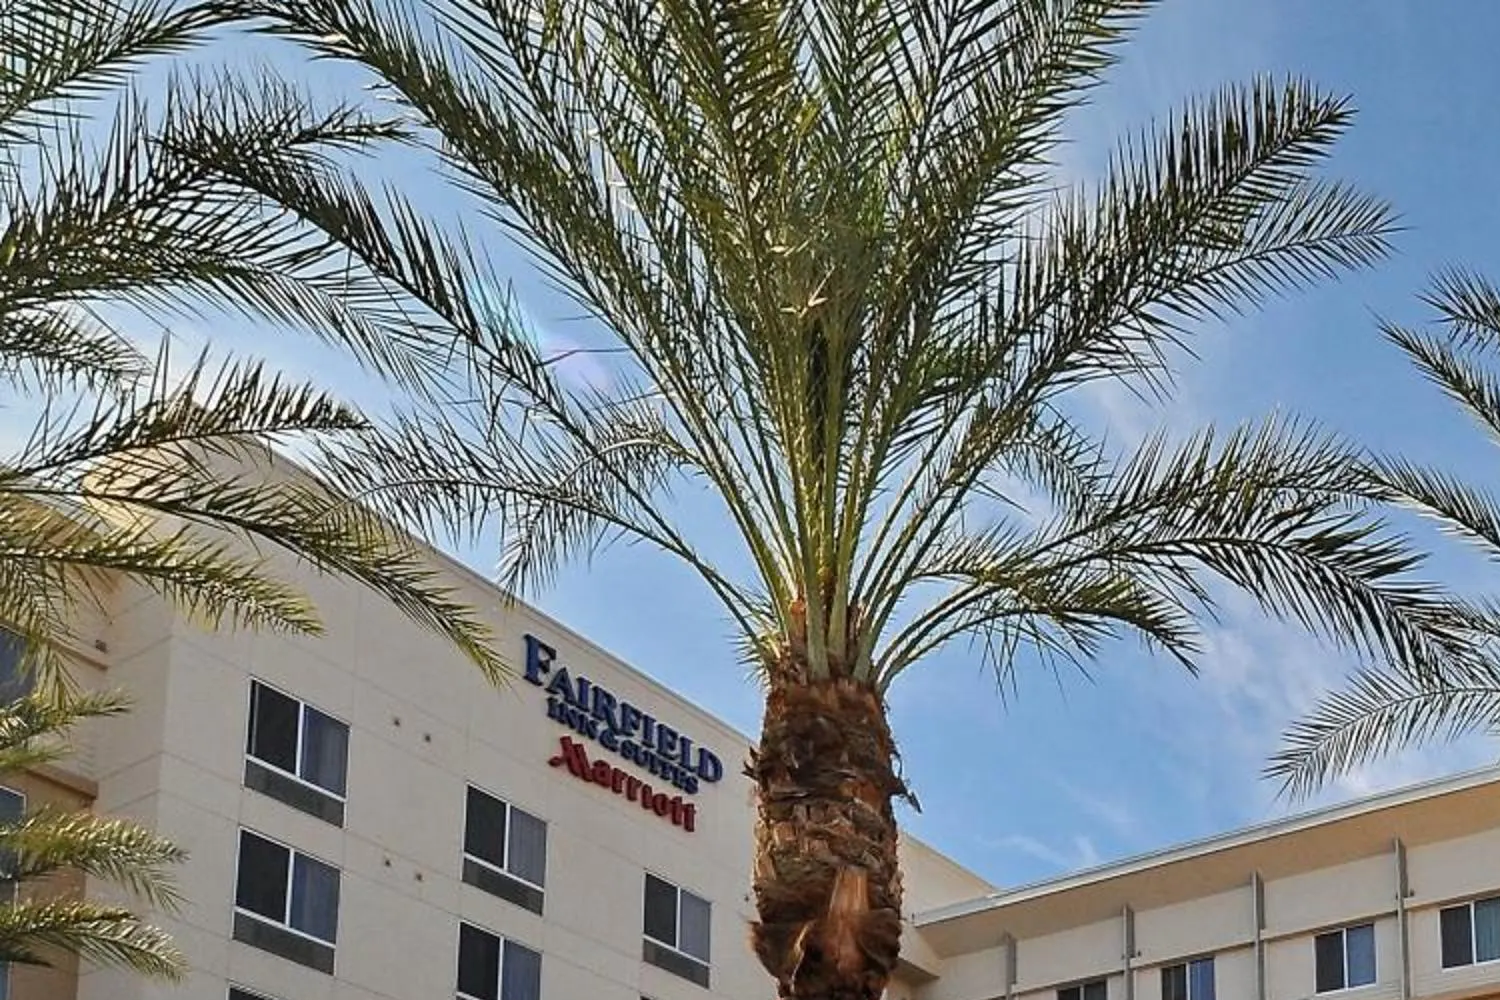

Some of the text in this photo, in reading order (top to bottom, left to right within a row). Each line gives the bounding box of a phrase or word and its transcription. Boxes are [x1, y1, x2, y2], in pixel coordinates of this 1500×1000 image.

[523, 634, 723, 782] FAIRFIELD
[546, 697, 699, 794] INN & SUITES
[548, 736, 696, 832] Marriott
